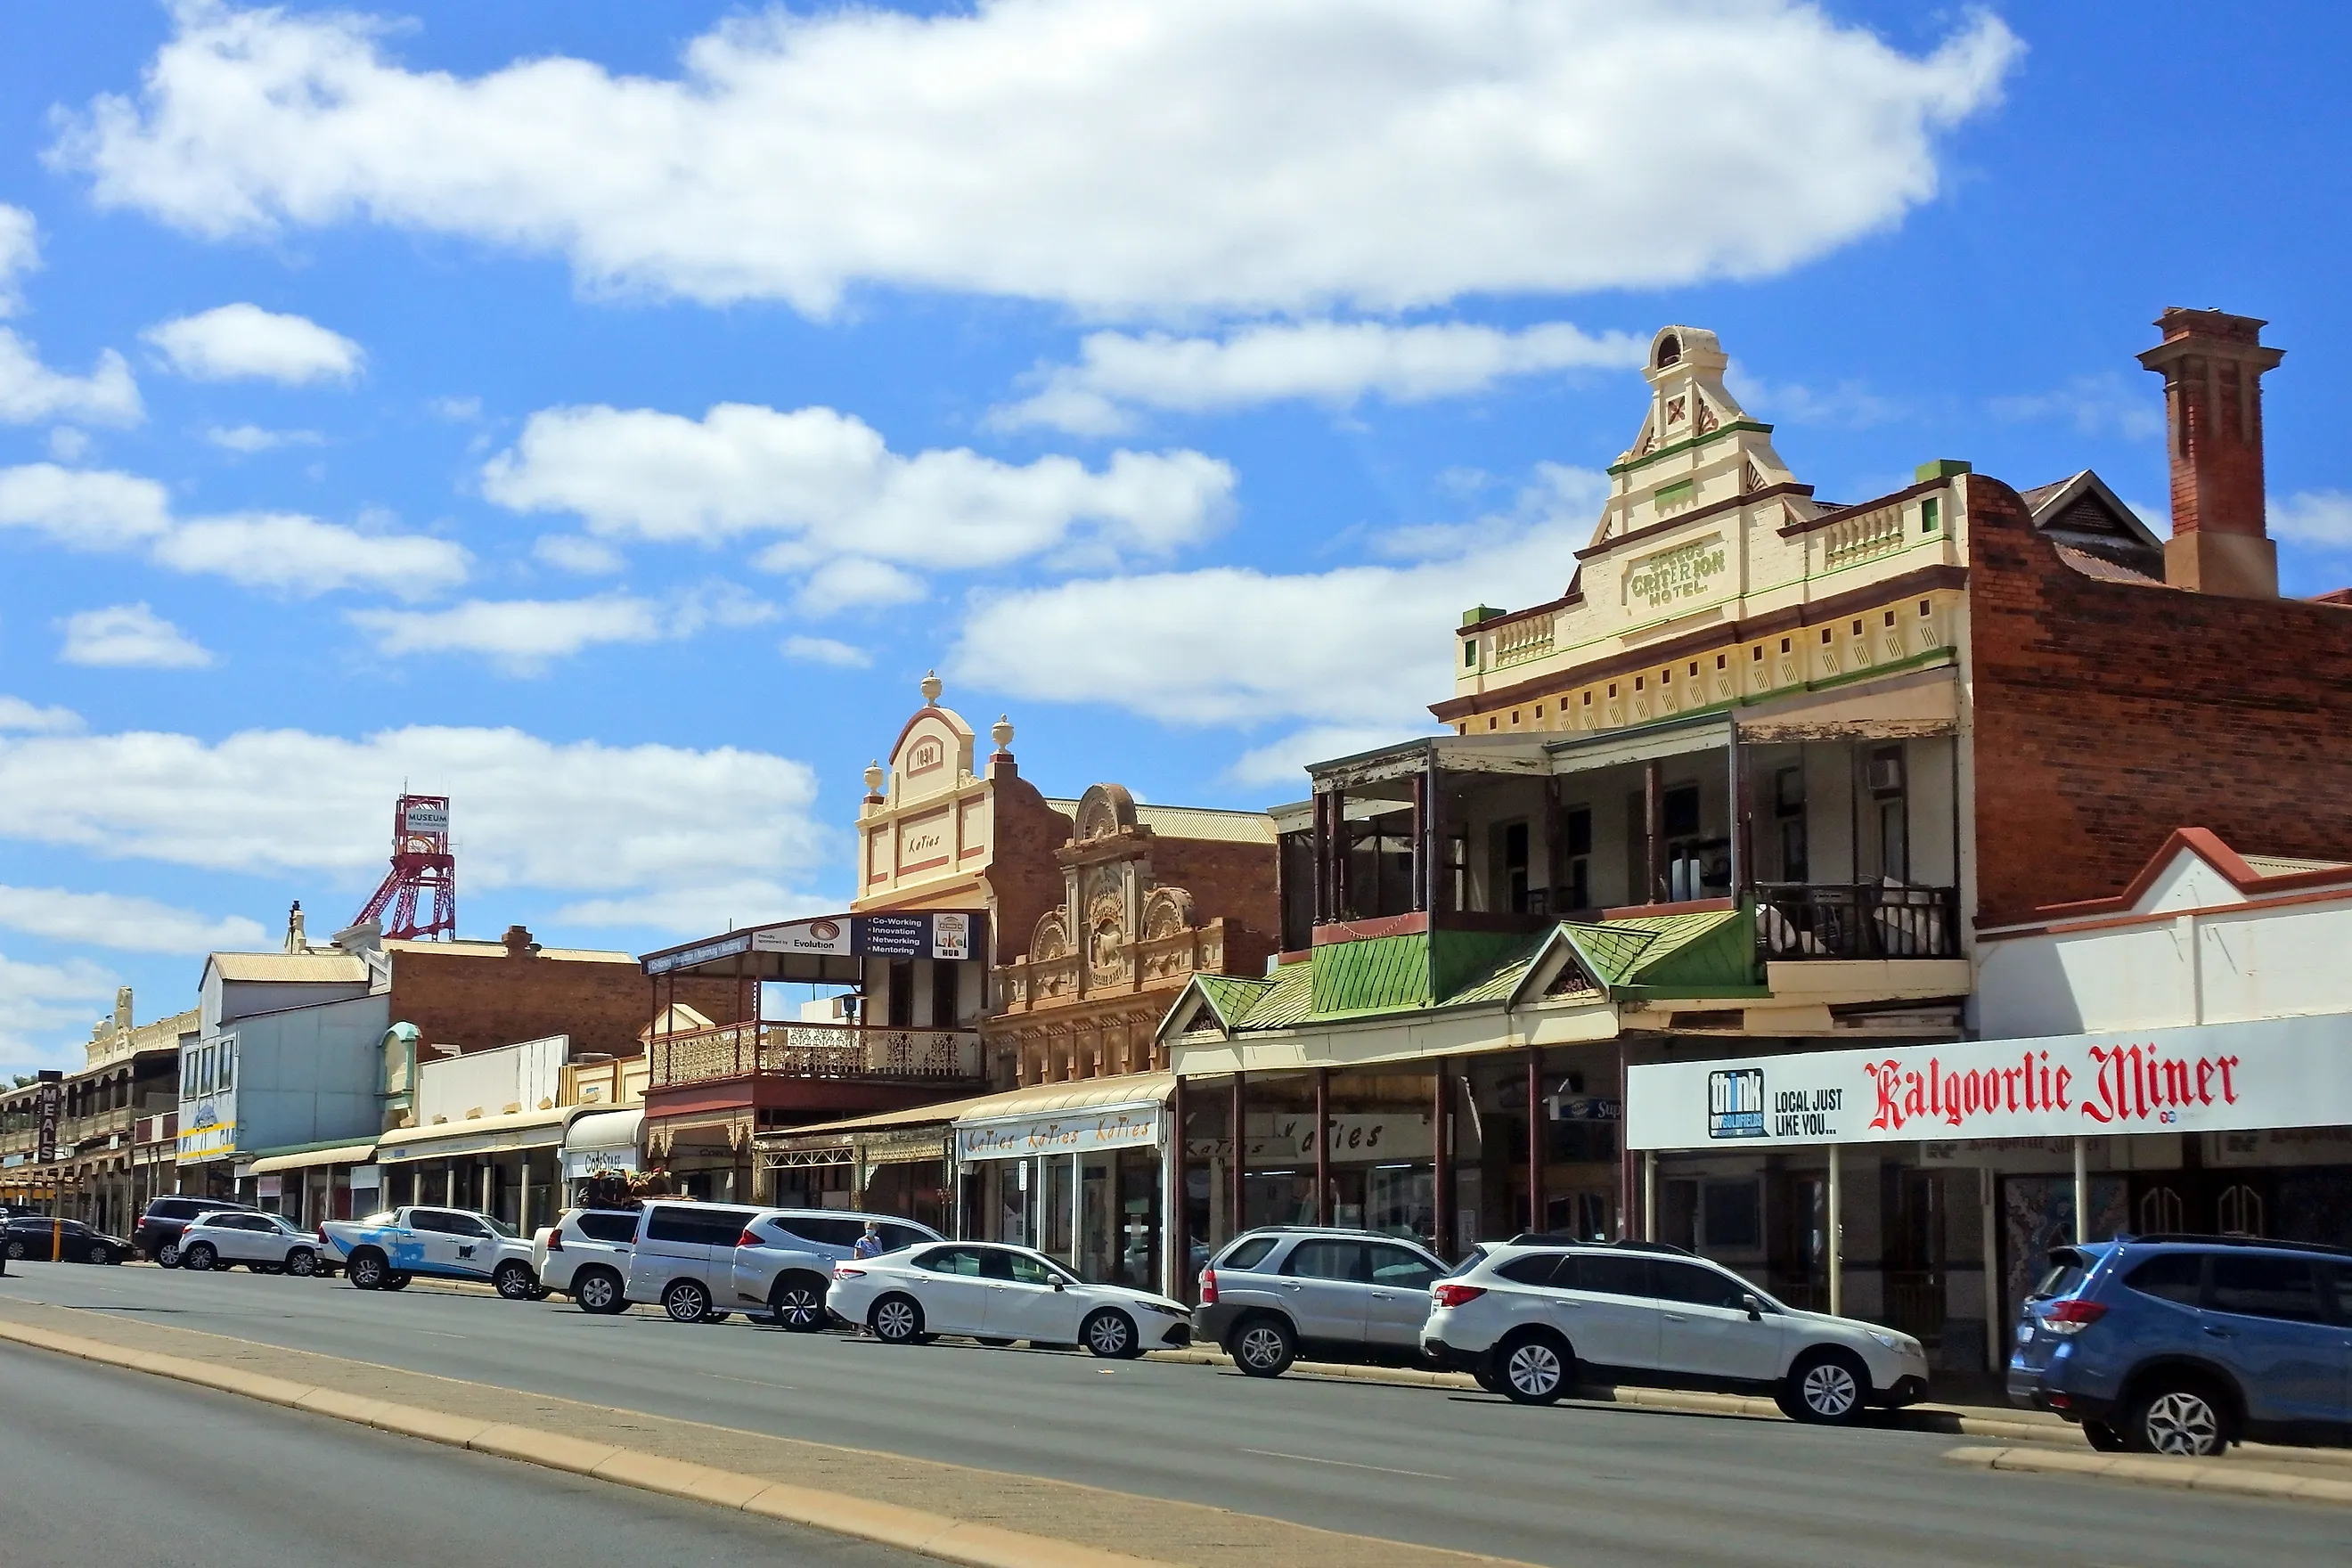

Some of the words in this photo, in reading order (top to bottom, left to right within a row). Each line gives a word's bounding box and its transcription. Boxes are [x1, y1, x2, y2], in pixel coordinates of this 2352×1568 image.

[1630, 549, 1726, 598] CRITERION
[408, 813, 447, 822] MUSEUM
[872, 917, 922, 927] Co-Working
[872, 927, 916, 935] Innovation
[794, 939, 835, 949] Evolution
[872, 935, 920, 946] Networking
[872, 945, 915, 955] Mentoring
[1711, 1070, 1761, 1114] think
[1864, 1049, 2074, 1131] Kalgoorlie
[2081, 1041, 2240, 1123] Miner
[1775, 1090, 1810, 1114] LOCAL
[1812, 1088, 1842, 1112] JUST
[41, 1089, 57, 1159] MEALS
[1776, 1115, 1800, 1137] LIKE
[1801, 1113, 1837, 1136] YOU...
